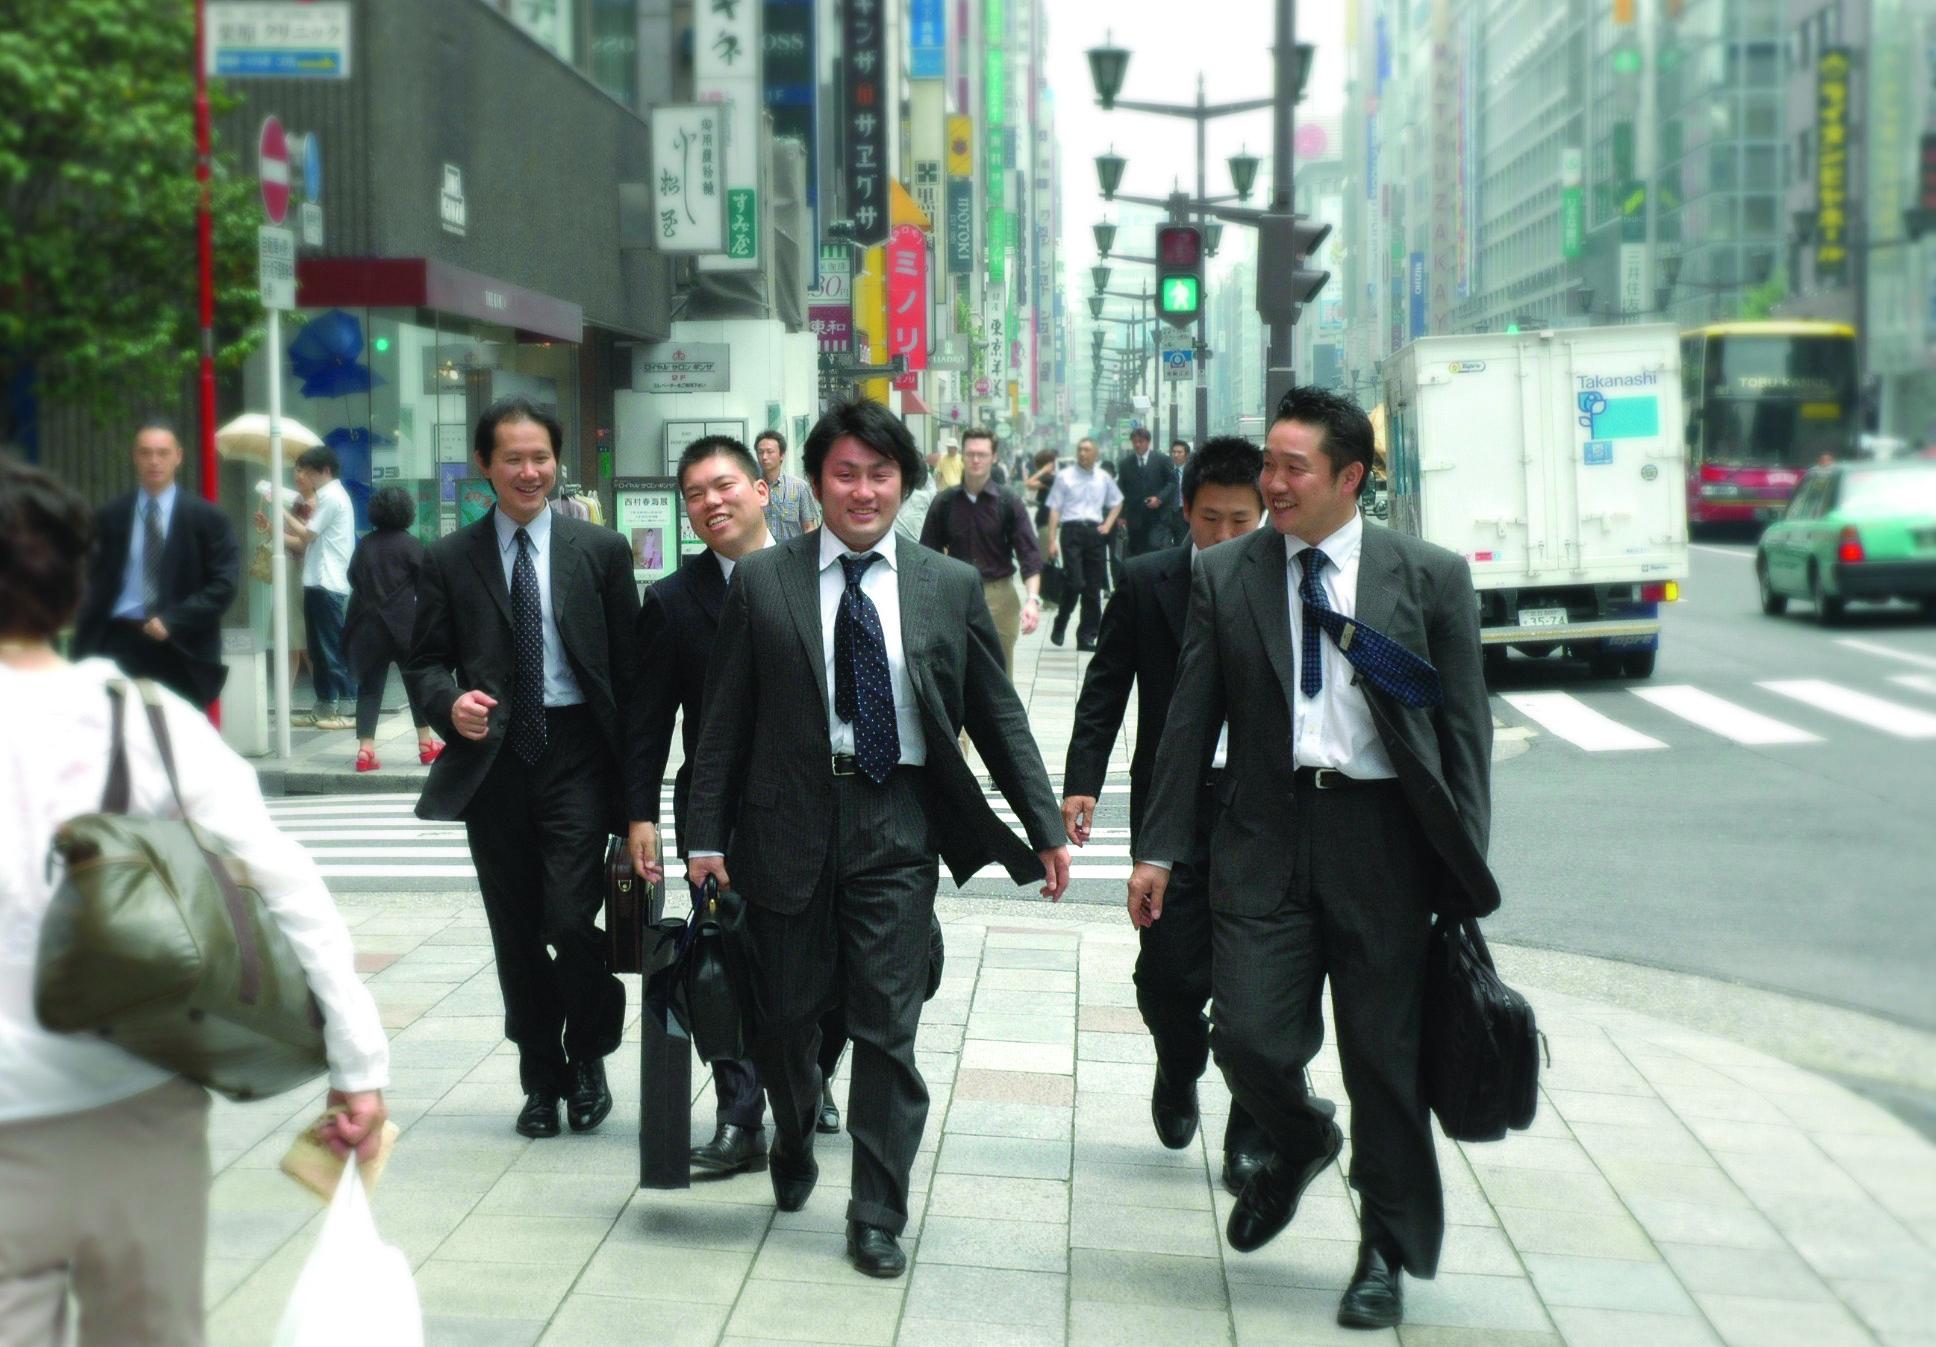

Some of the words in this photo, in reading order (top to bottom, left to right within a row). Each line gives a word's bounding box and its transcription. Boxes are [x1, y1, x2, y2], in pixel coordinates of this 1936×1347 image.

[895, 251, 918, 352] ミノリ
[1576, 371, 1657, 389] Takanashi
